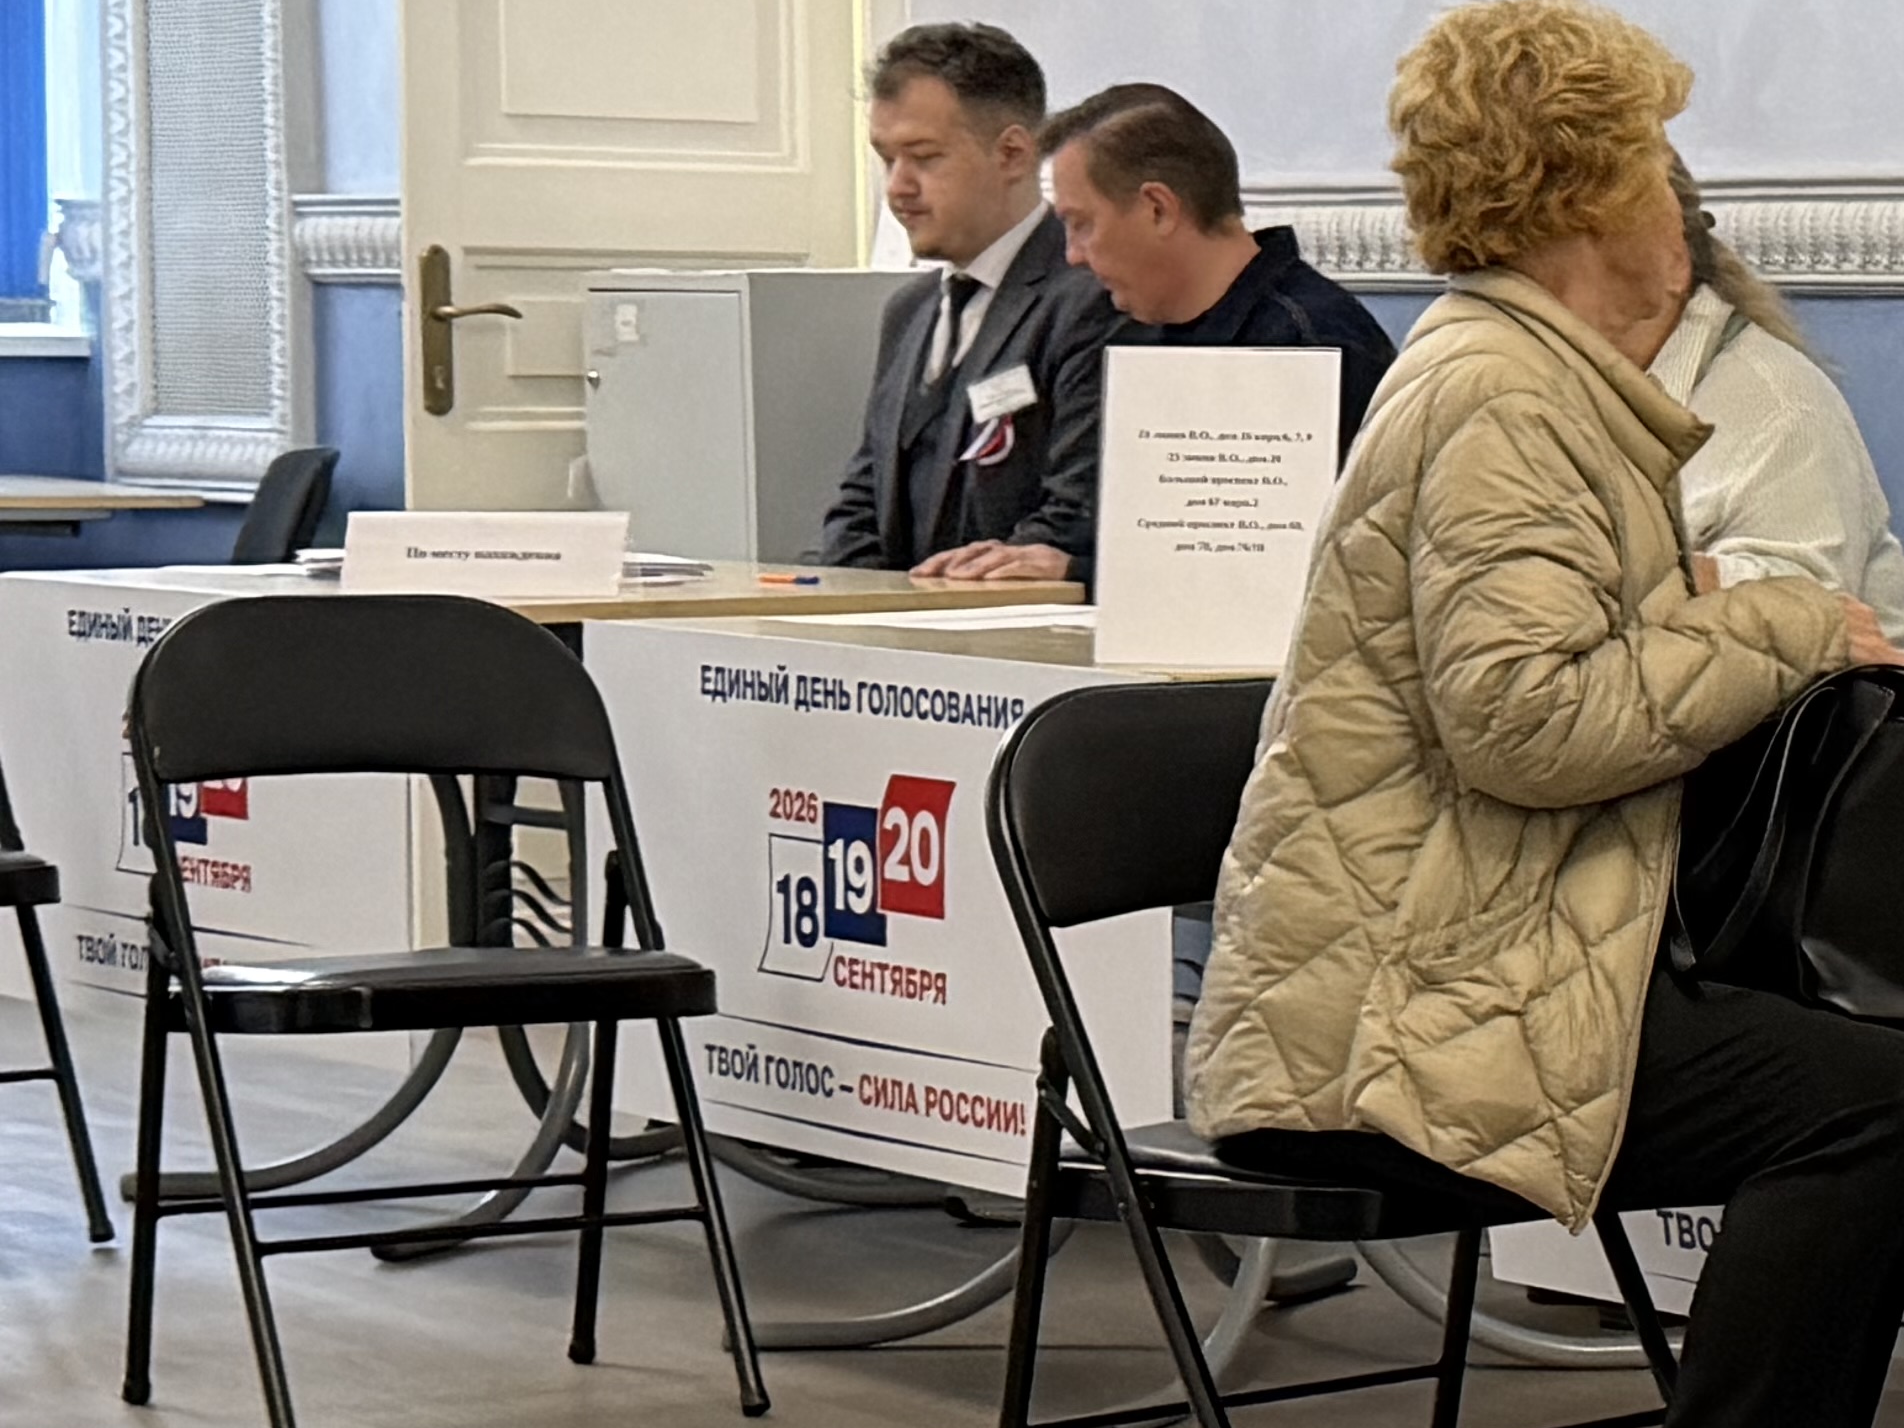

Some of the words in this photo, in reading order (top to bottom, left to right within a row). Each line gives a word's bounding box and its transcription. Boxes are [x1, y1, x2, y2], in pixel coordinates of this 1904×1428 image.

[407, 546, 427, 559] По
[68, 607, 133, 642] ЕДИНЫЙ
[136, 615, 172, 647] ДЕ
[701, 664, 789, 705] ЕДИНЫЙ
[794, 674, 851, 713] ДЕНЬ
[857, 680, 1025, 729] ГОЛОСОВАНИЯ
[769, 788, 818, 823] 2026
[181, 856, 252, 894] ЕНТЯБРЯ
[776, 873, 819, 948] 18
[828, 838, 874, 914] 19
[883, 806, 940, 886] 20
[76, 933, 117, 966] ТВОЙ
[122, 943, 149, 970] ГОЛ
[833, 955, 947, 1006] СЕНТЯБРЯ
[704, 1043, 759, 1084] ТВОЙ
[765, 1055, 834, 1098] ГОЛОС
[858, 1073, 919, 1116] СИЛА
[925, 1085, 1026, 1137] РОССИИ!
[1656, 1210, 1714, 1252] ТВО
